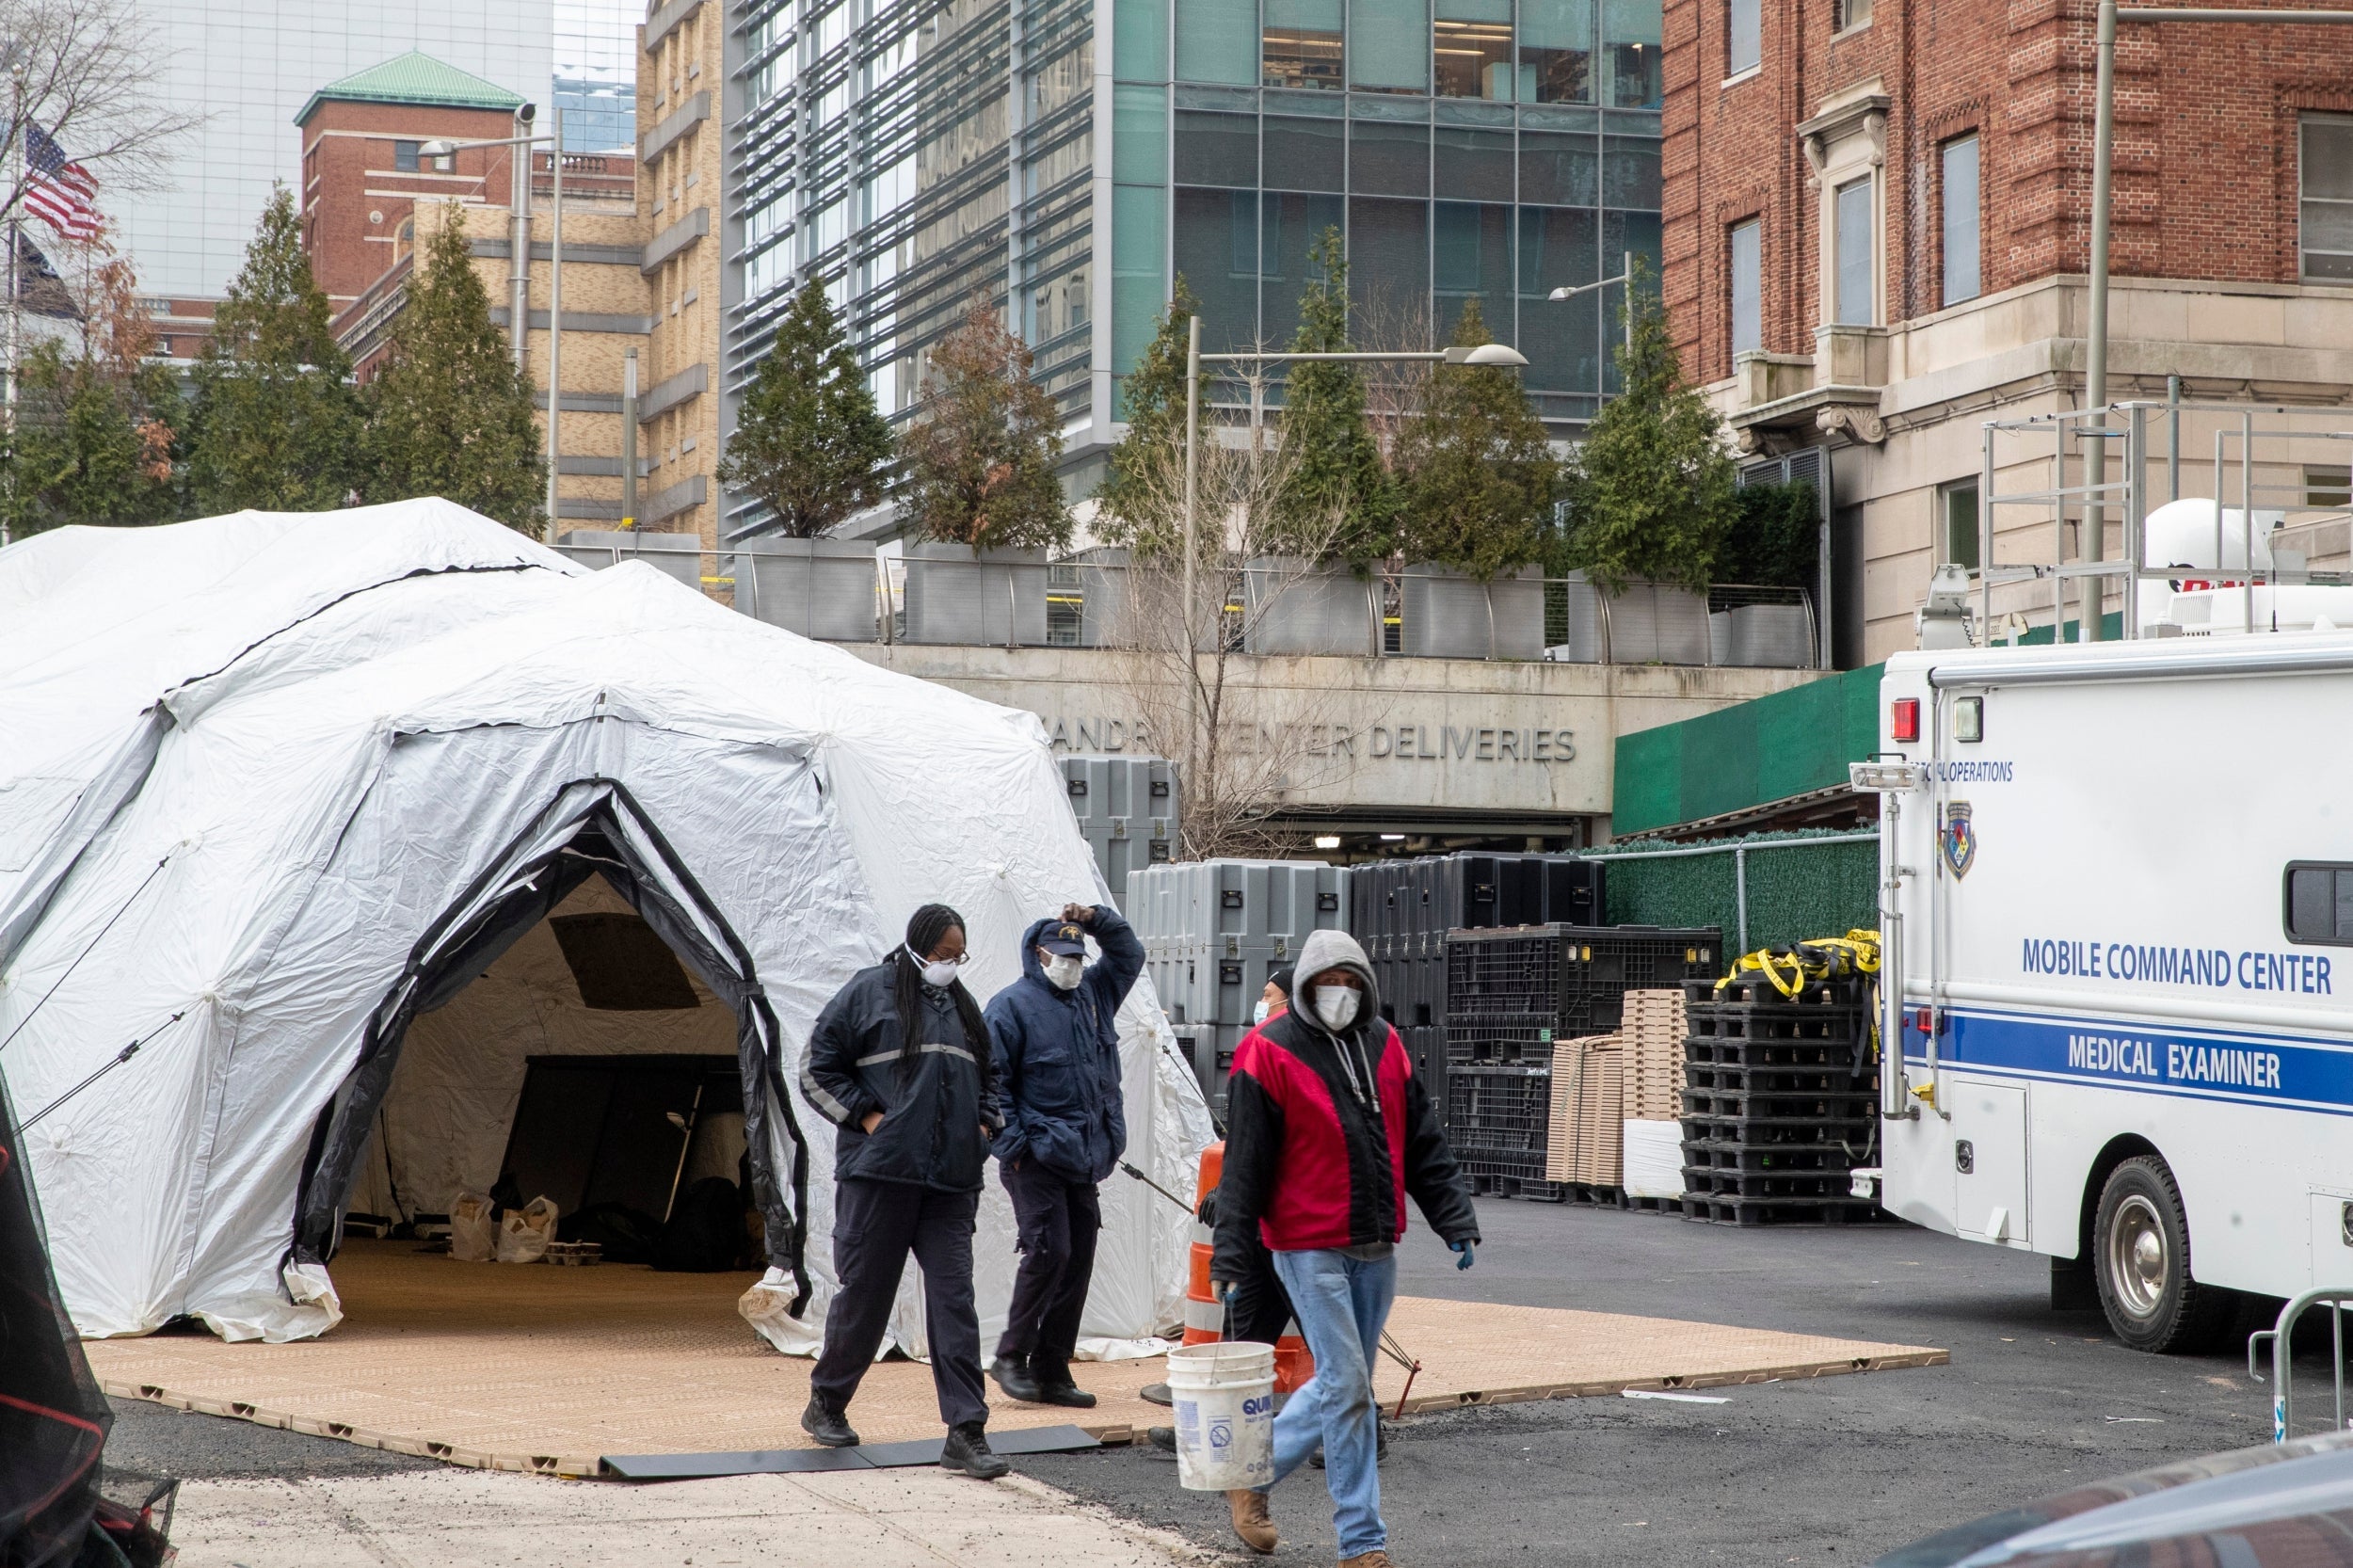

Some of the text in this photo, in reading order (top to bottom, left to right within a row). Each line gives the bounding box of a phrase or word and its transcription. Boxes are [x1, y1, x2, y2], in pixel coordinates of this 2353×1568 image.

[1369, 724, 1577, 762] DELIVERIES
[1949, 760, 2013, 782] OPERATIONS
[2023, 937, 2331, 995] MOBILE COMMAND CENTER
[2069, 1034, 2281, 1089] MEDICAL EXAMINER
